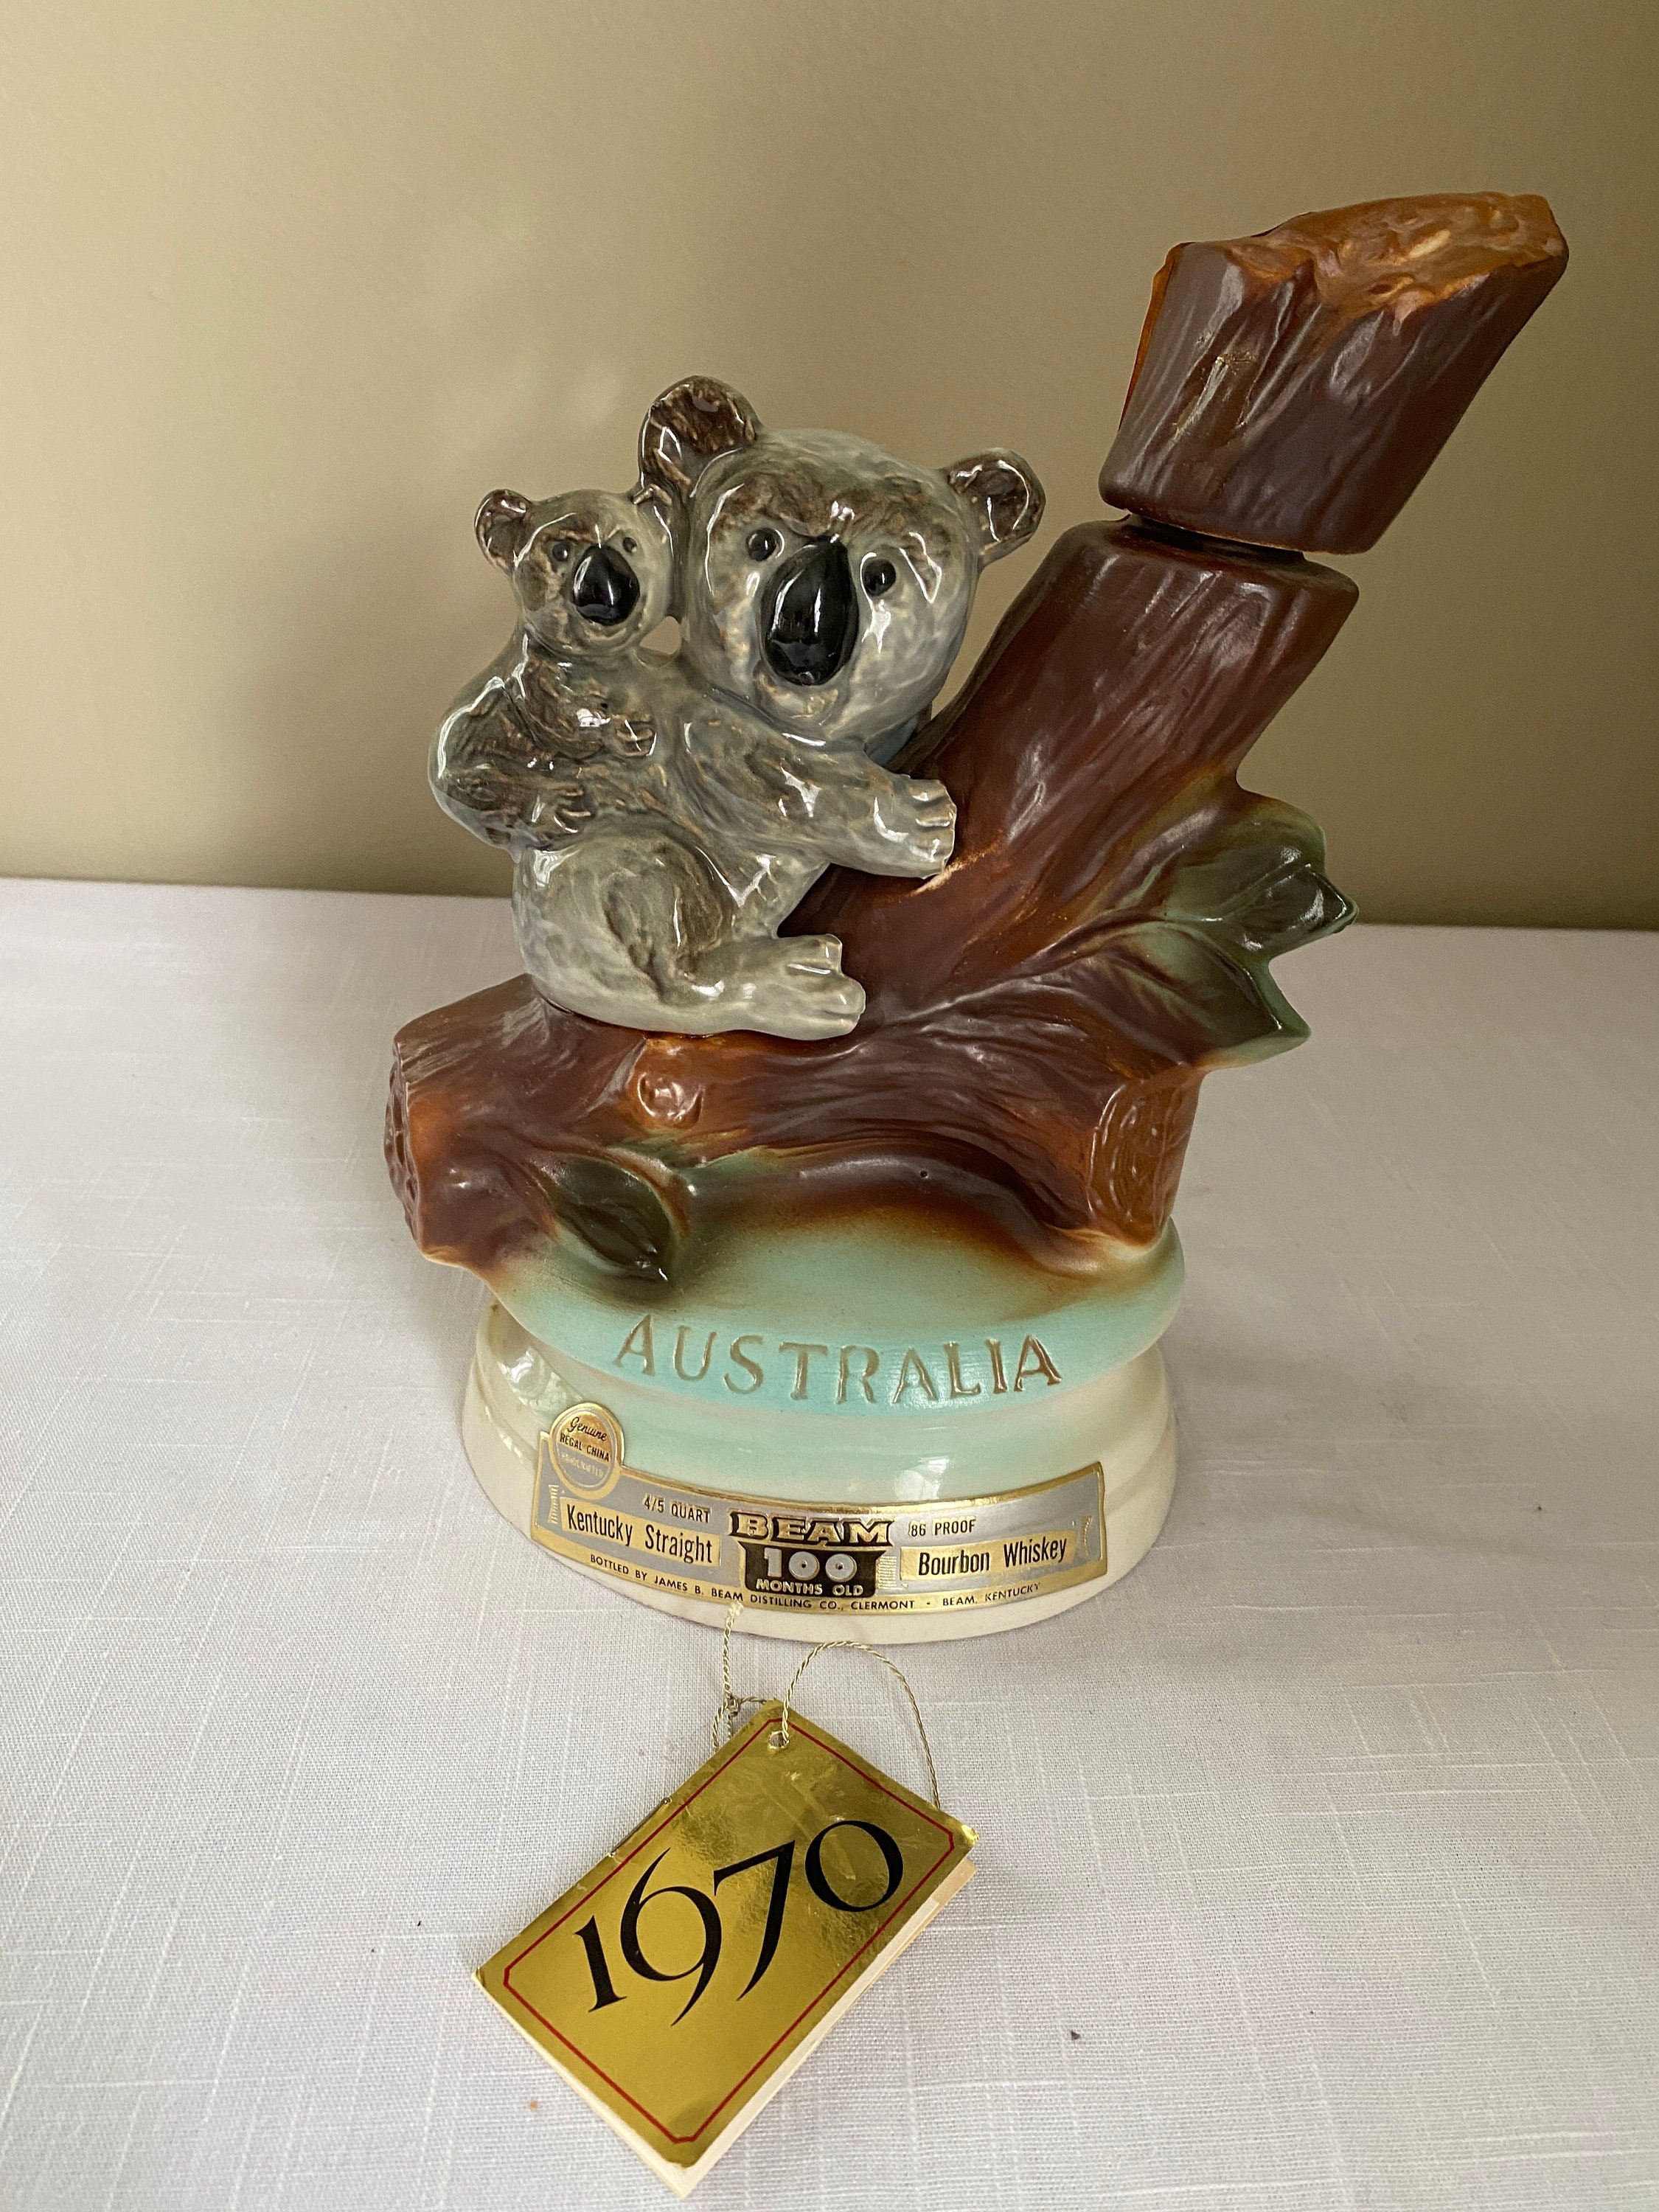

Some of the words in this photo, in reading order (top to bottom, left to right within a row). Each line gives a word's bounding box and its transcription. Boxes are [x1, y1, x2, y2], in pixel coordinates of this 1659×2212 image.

[613, 1313, 1062, 1404] AUSTRALIA
[567, 1416, 608, 1441] Genuine
[560, 1433, 582, 1450] REGAL
[586, 1444, 610, 1461] CHINA
[644, 1496, 664, 1513] 4/5
[670, 1503, 711, 1523] QUART
[566, 1503, 633, 1547] Kentucky
[644, 1523, 713, 1564] Straight
[729, 1511, 894, 1547] BEAM
[910, 1523, 927, 1537] 86
[934, 1519, 976, 1536] PROOF
[763, 1547, 858, 1583] 100
[918, 1549, 990, 1576] Bourbon
[1004, 1537, 1068, 1568] Whiskey
[590, 1554, 630, 1575] BOTTLED
[635, 1570, 647, 1581] BY
[653, 1575, 688, 1591] JAMES
[694, 1585, 704, 1596] B.
[711, 1587, 744, 1601] BEAM
[750, 1594, 812, 1609] DISTILLING
[850, 1599, 915, 1610] CLERMONT
[984, 1582, 1042, 1601] KENTUCKY
[755, 1578, 823, 1595] MONTHS
[832, 1584, 864, 1596] OLD
